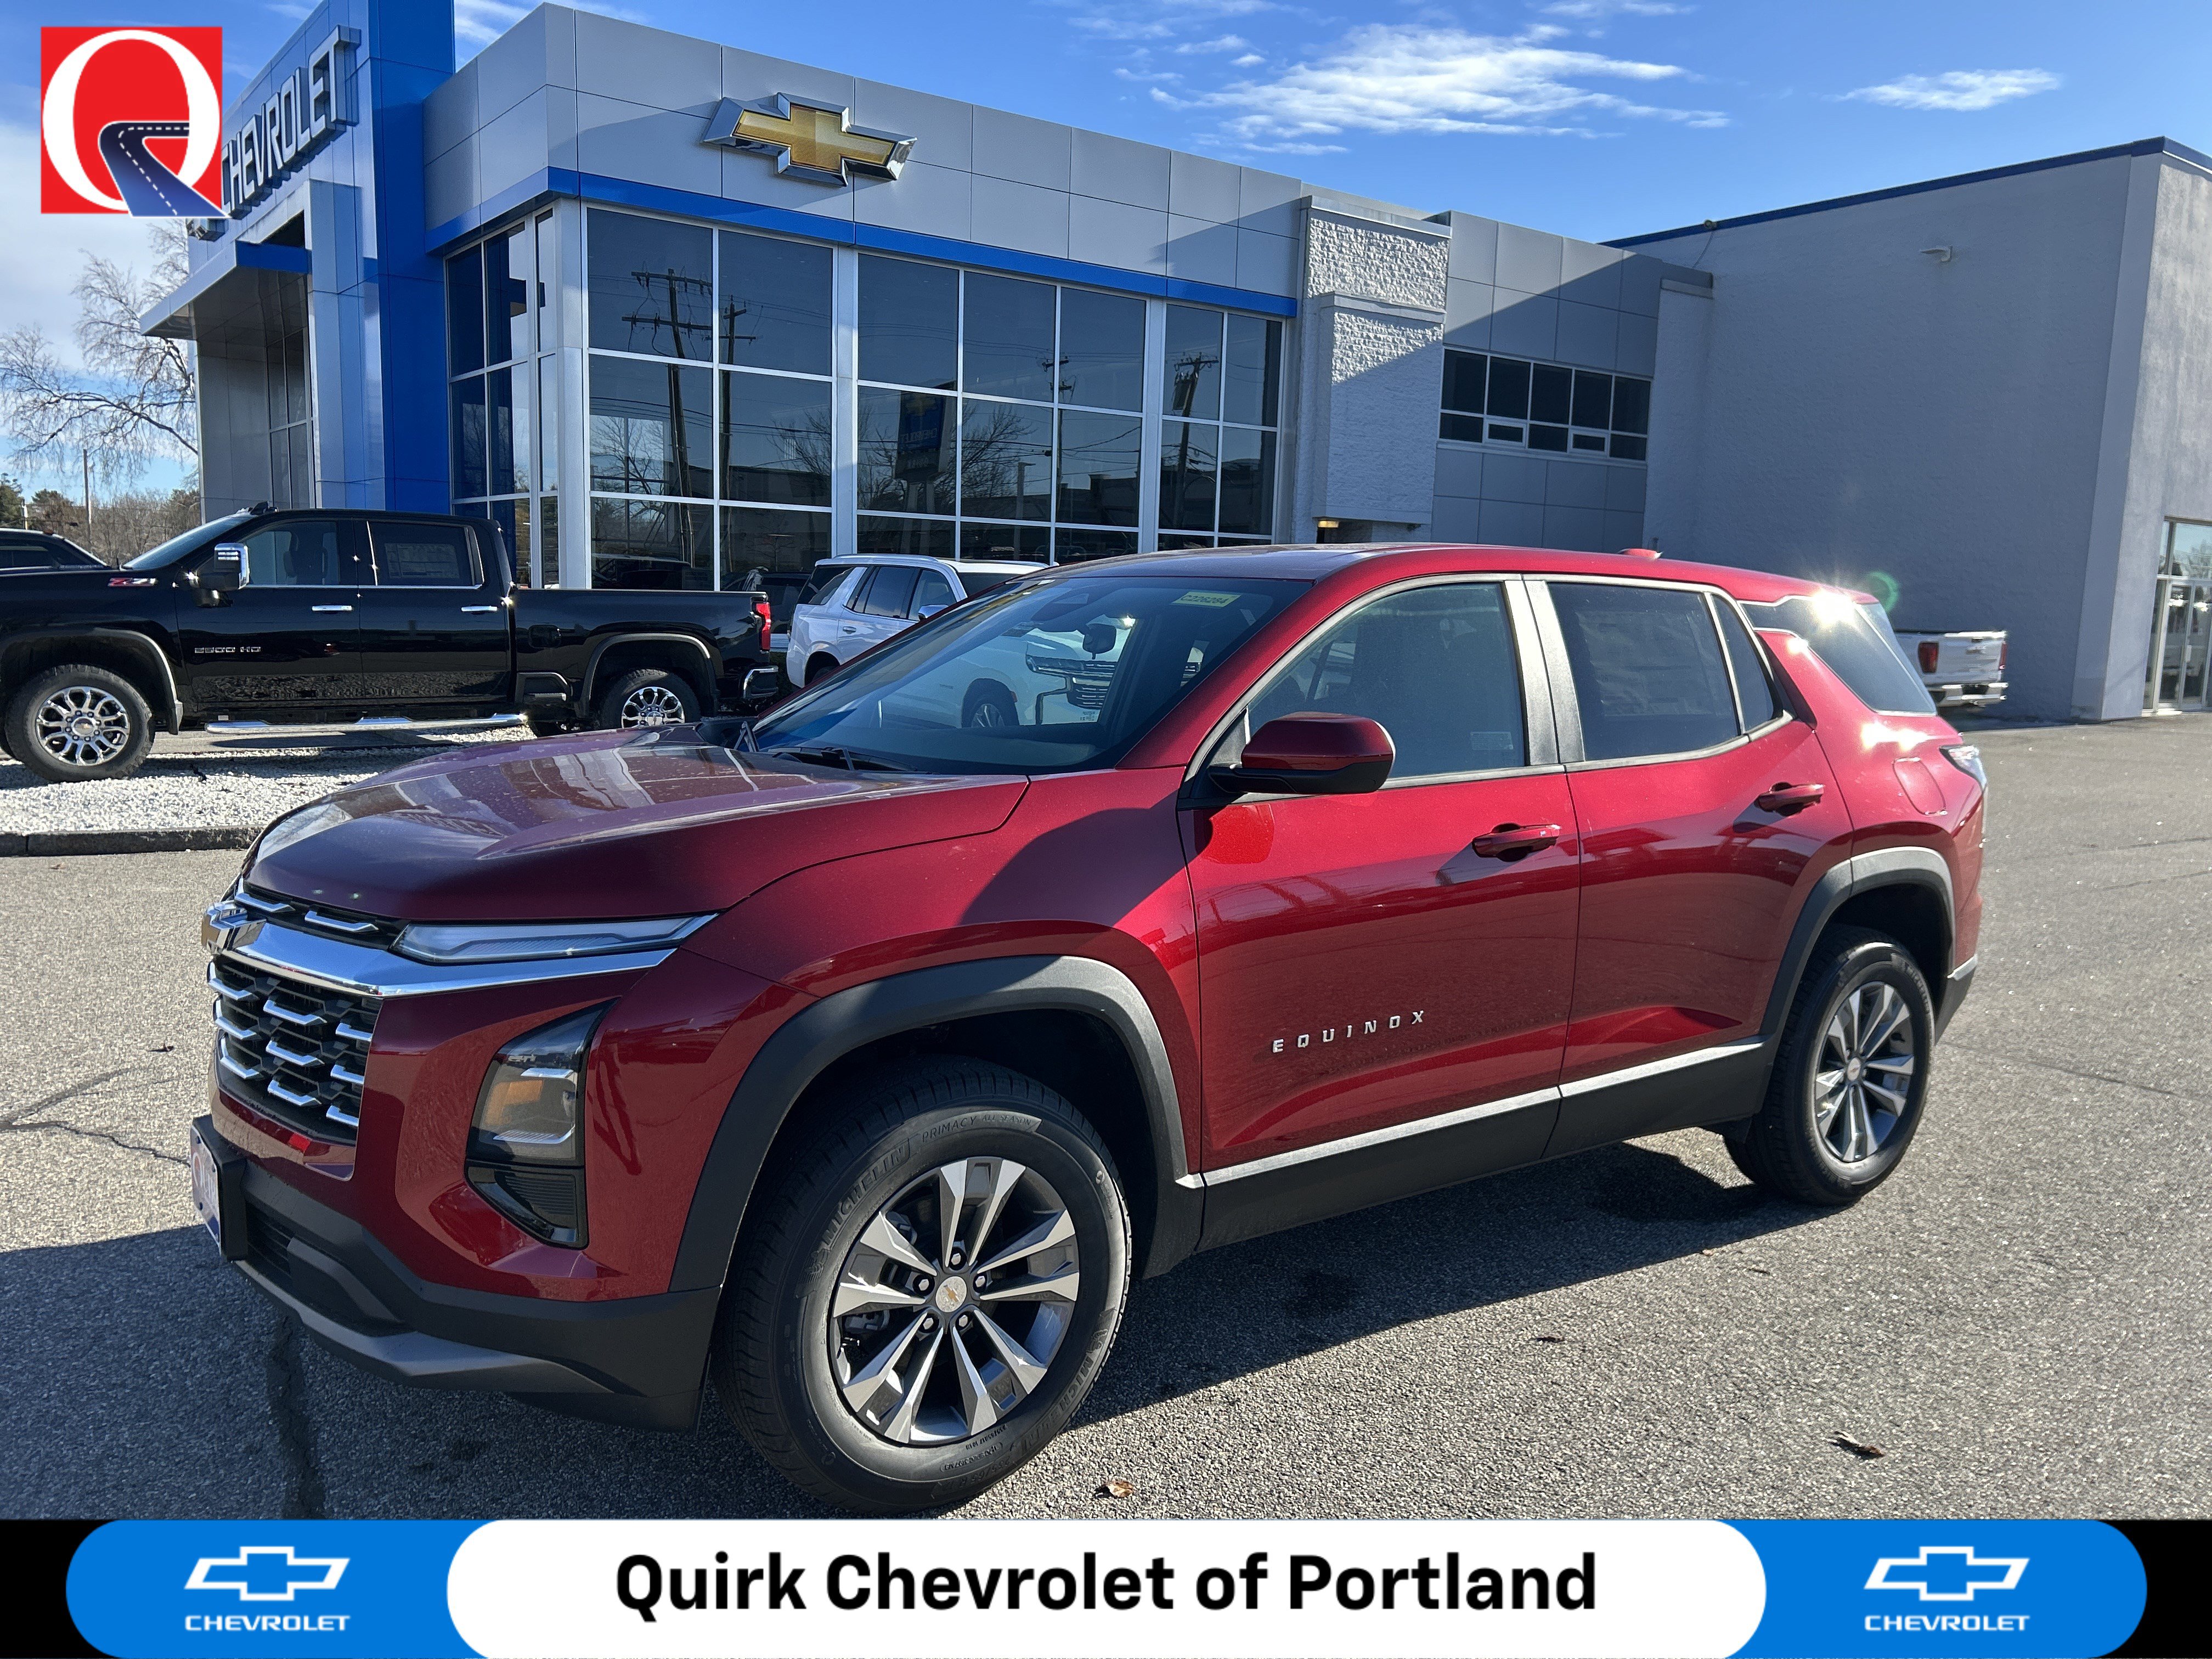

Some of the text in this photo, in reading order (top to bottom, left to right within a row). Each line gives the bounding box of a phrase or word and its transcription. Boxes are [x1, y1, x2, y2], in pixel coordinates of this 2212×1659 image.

[1272, 1009, 1425, 1053] EQUINOX
[822, 1143, 907, 1246] MICHELIN
[922, 1115, 978, 1143] PRIMACY
[1020, 1355, 1094, 1452] MICHELIN
